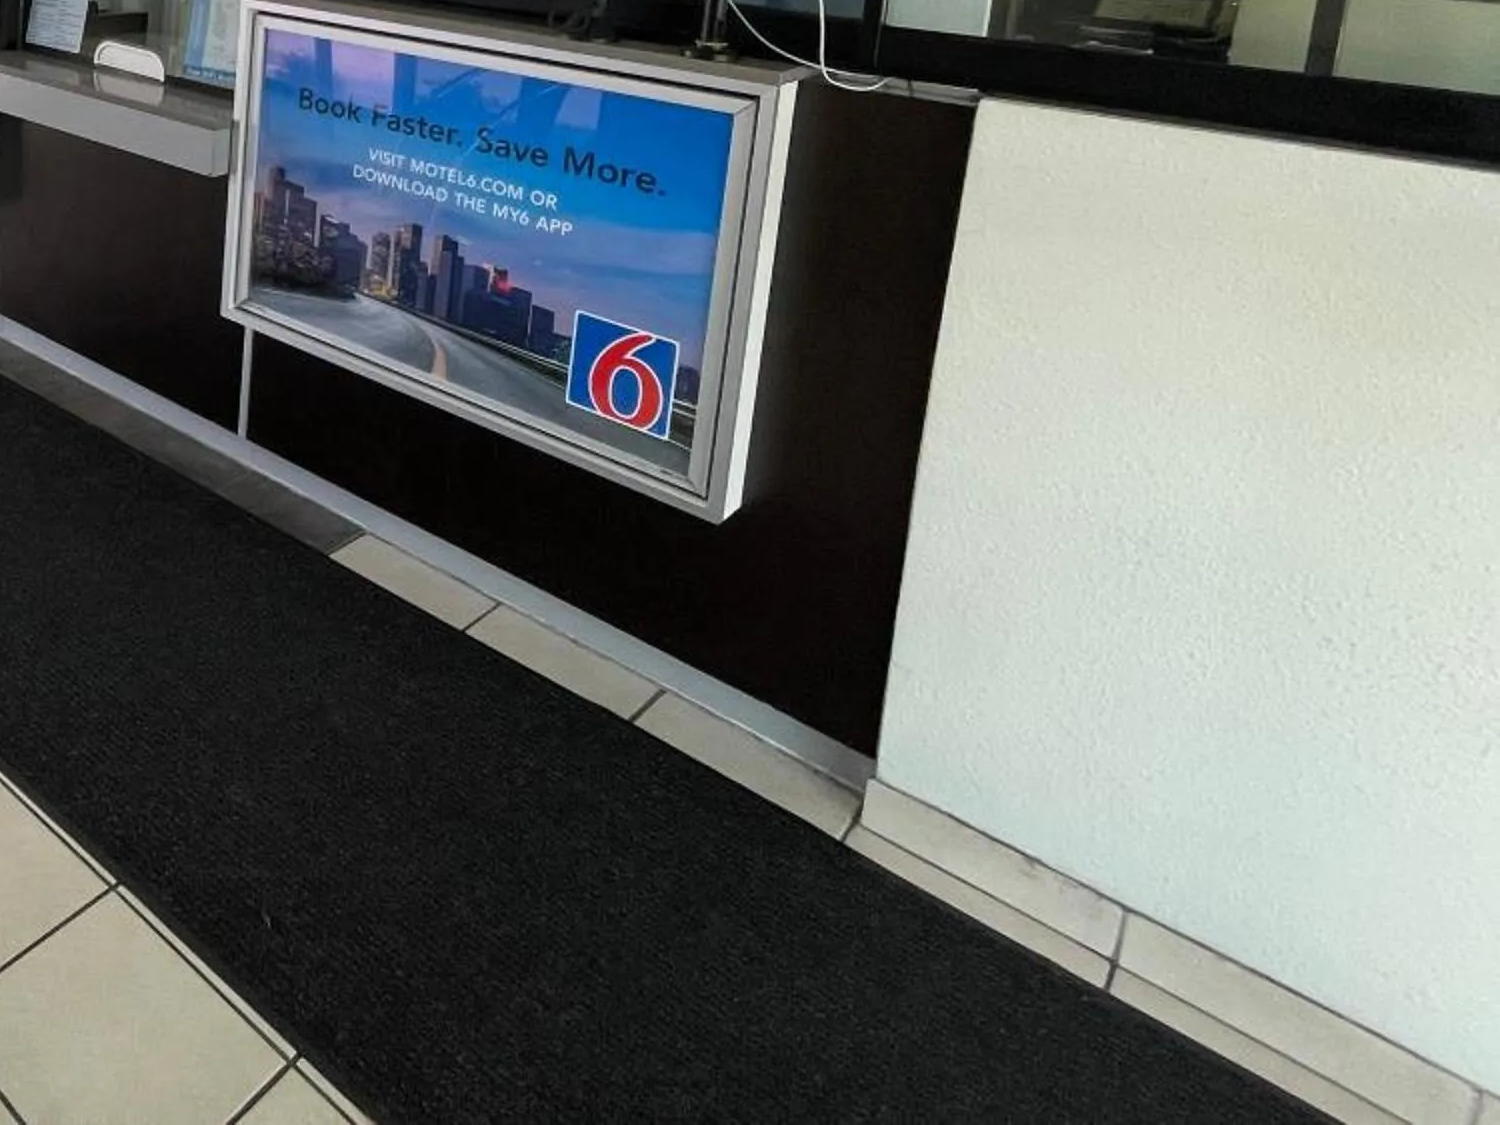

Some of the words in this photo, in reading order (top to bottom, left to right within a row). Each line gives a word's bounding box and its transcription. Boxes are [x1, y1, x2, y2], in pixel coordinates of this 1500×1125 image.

[299, 87, 362, 124] Book
[372, 104, 463, 148] Faster.
[475, 126, 549, 168] Save
[563, 146, 667, 197] More.
[368, 146, 408, 169] VISIT
[409, 158, 524, 202] MOTEL6.COM
[529, 190, 559, 212] OR
[352, 164, 449, 203] DOWNLOAD
[453, 192, 487, 215] THE
[492, 202, 531, 226] MY6
[535, 216, 574, 237] APP
[588, 331, 664, 433] 6
